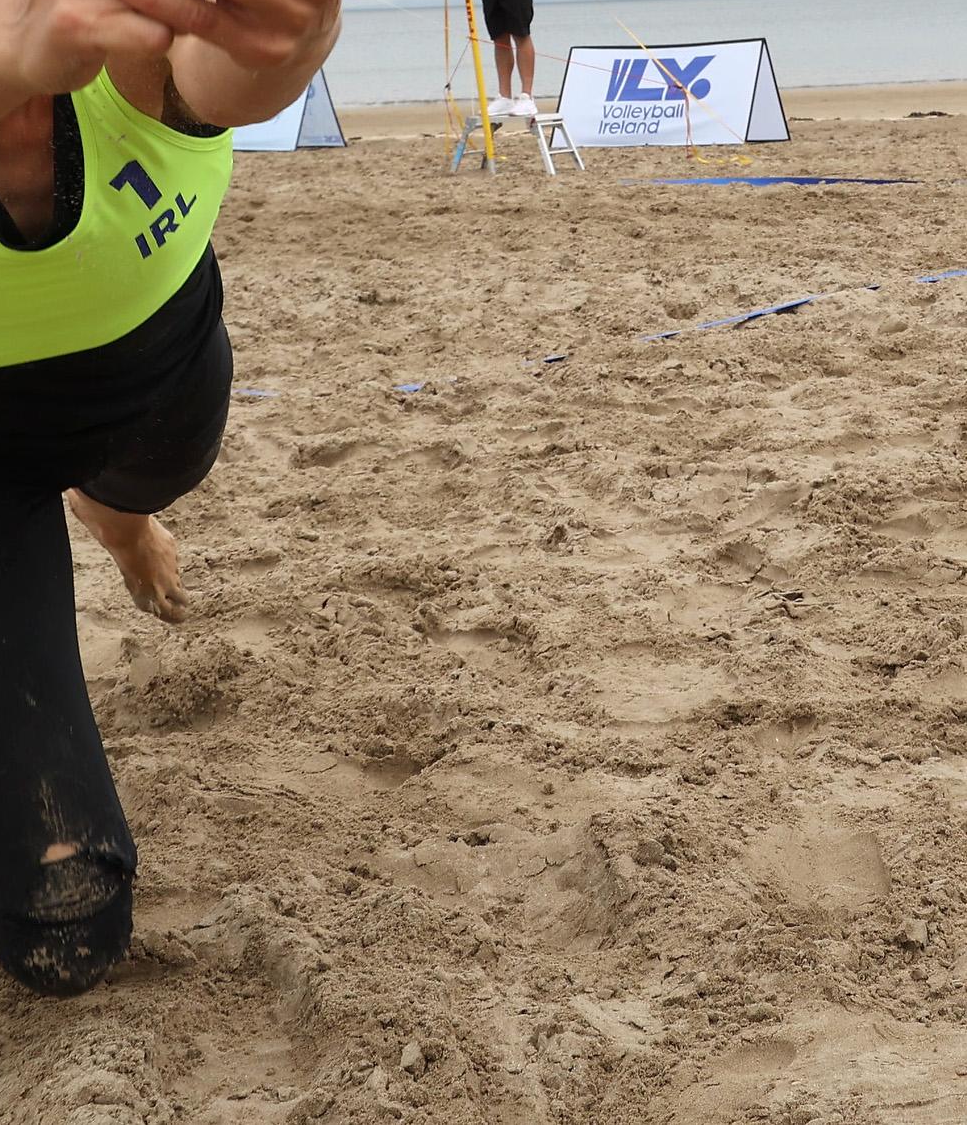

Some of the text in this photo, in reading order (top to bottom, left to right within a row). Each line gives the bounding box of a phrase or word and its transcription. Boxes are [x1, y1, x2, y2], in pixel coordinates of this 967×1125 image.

[598, 119, 660, 134] Ireland
[602, 103, 685, 120] Volleyball
[109, 159, 163, 211] 1
[135, 191, 197, 259] IRL
